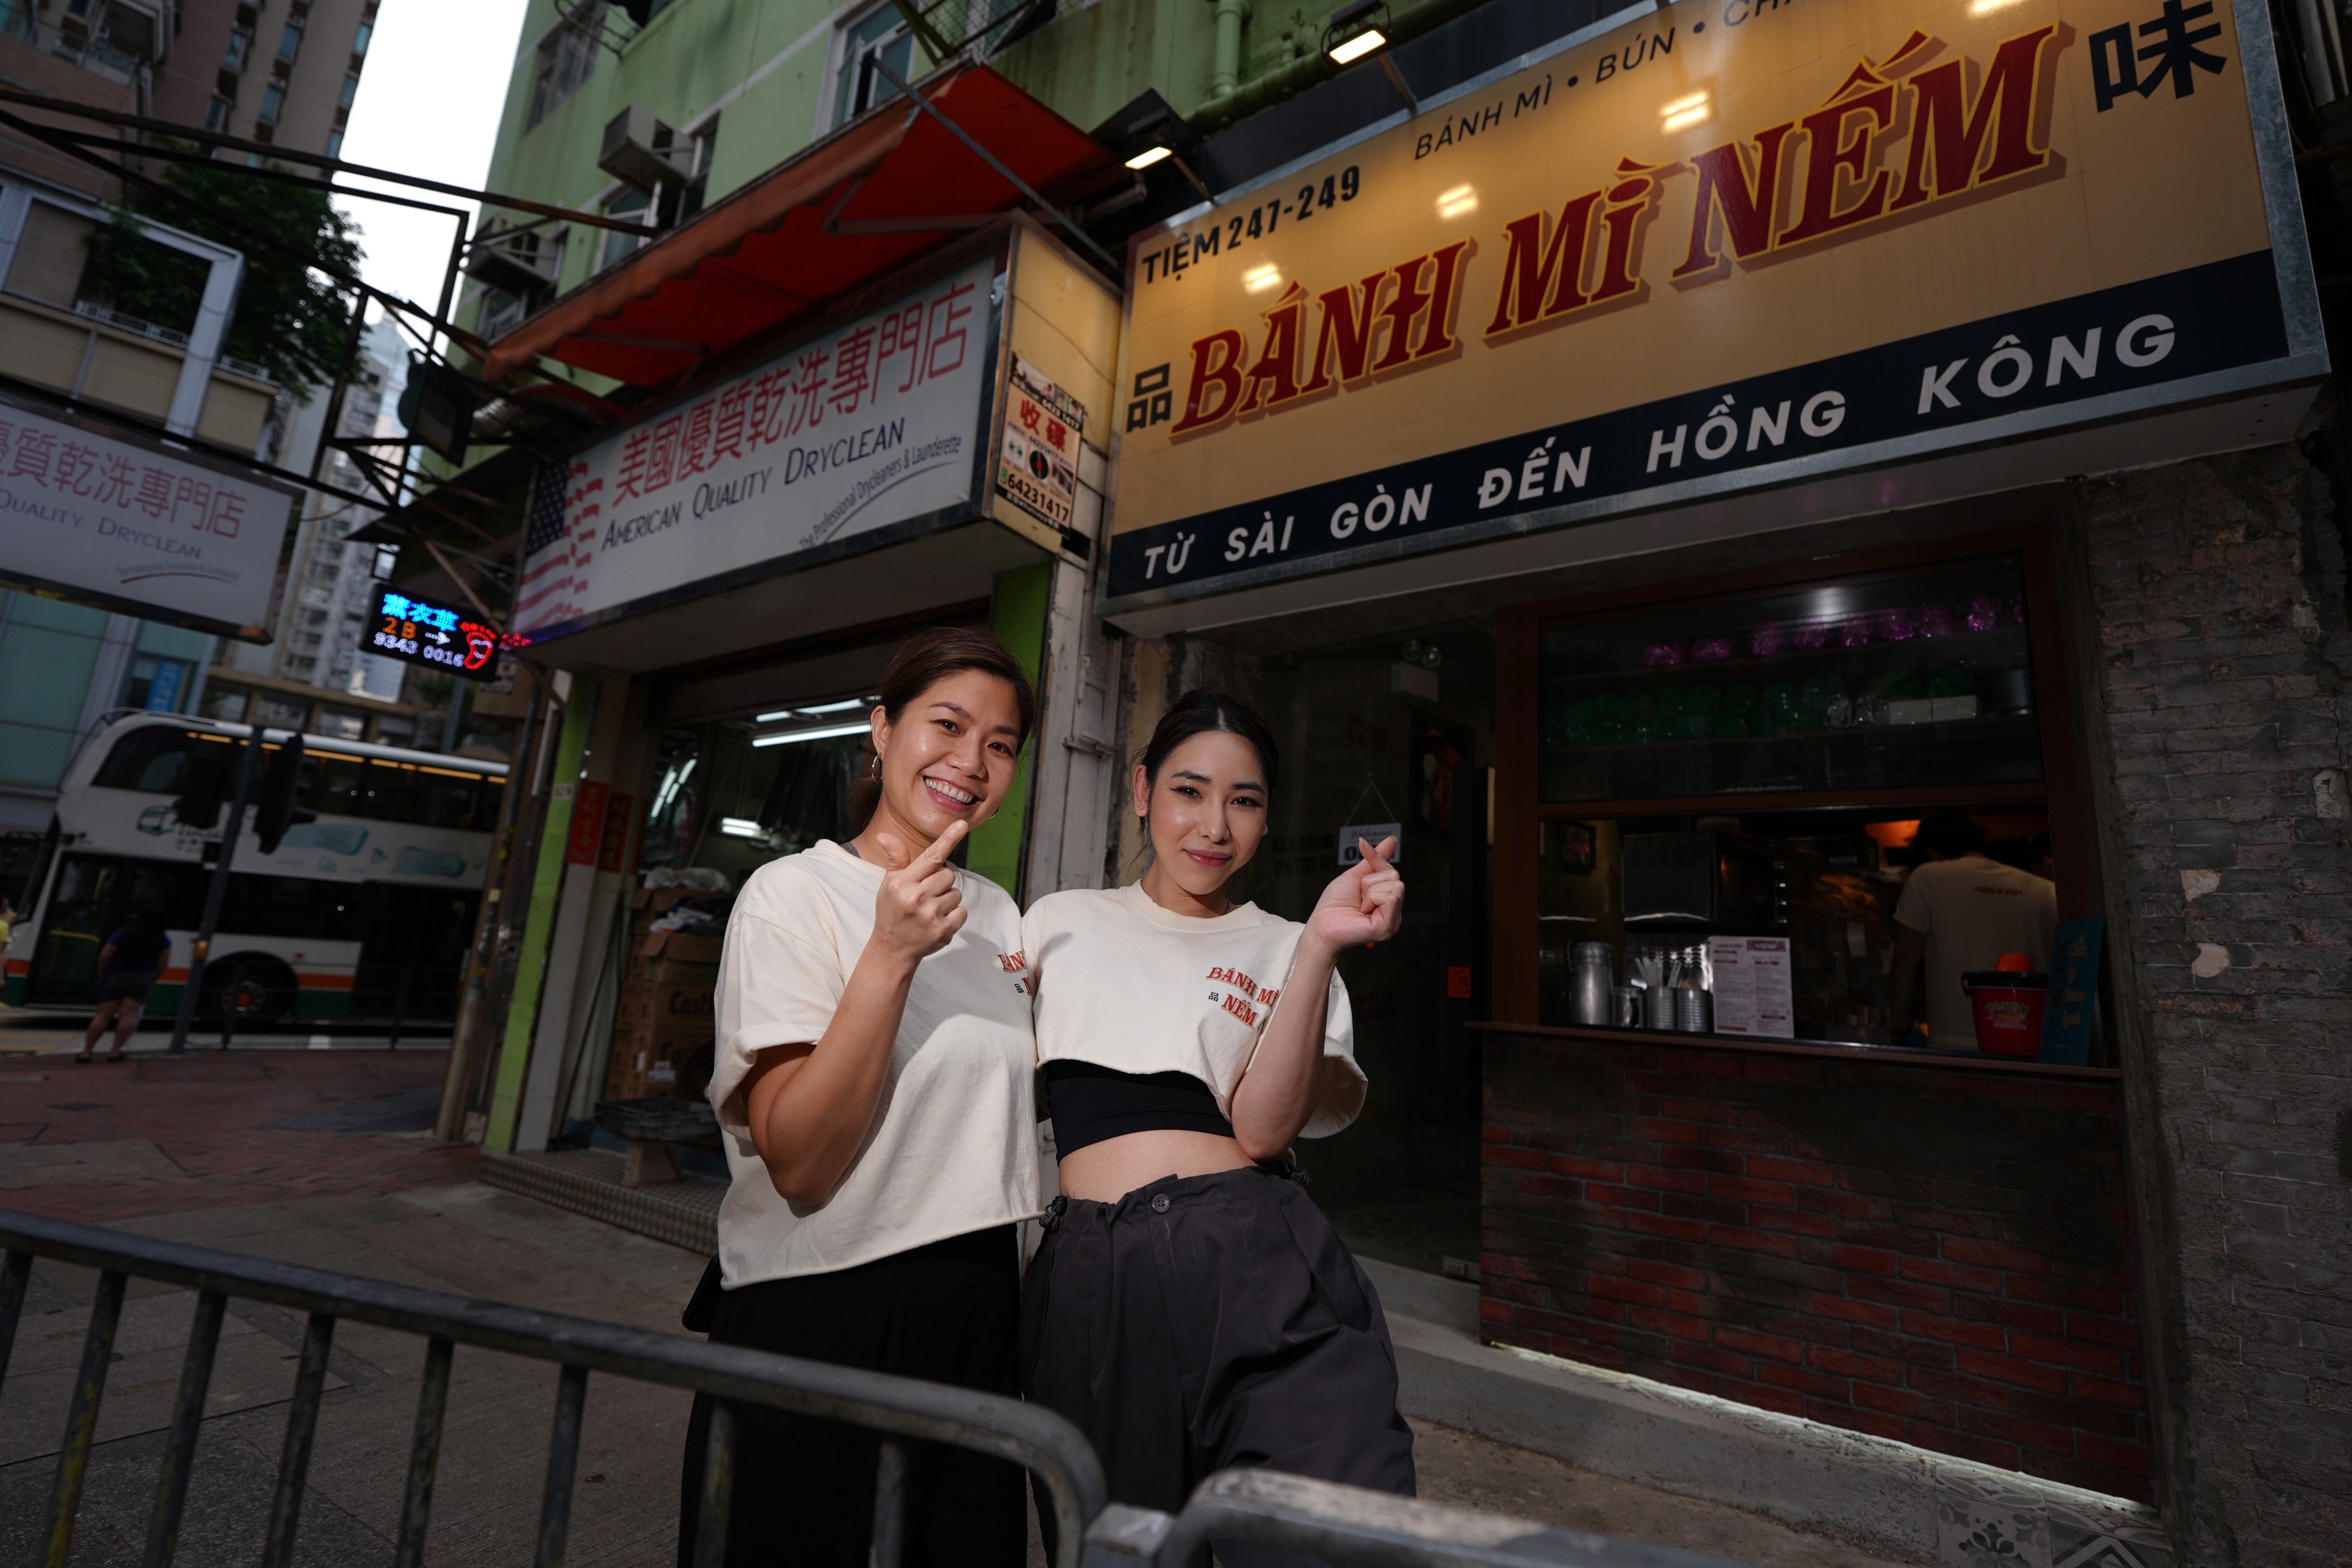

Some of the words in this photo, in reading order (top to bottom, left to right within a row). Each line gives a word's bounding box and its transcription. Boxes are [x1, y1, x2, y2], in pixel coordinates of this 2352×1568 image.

[1415, 102, 1502, 161] BÁNH
[1514, 75, 1553, 117] MÌ
[1594, 27, 1676, 83] BÚN
[1724, 0, 1791, 26] CH
[2088, 0, 2227, 113] 味
[1142, 225, 1221, 284] TIỆM
[1226, 166, 1360, 250] 247-249
[1169, 237, 1477, 442] BÁNH
[1482, 154, 1678, 346] MÌ
[1670, 21, 2070, 286] NẾM
[612, 281, 976, 509] 美國優質乾洗專門店
[1019, 398, 1067, 453] 收碟
[1041, 397, 1063, 420] 6423
[1062, 410, 1080, 431] 1417
[1126, 363, 1171, 433] 品
[1144, 531, 1196, 579] TỪ
[1223, 512, 1295, 562] SÀI
[1330, 483, 1433, 539] GÒN
[1477, 436, 1592, 509] ĐẾN
[1646, 395, 1846, 473] HỒNG
[1918, 314, 2176, 415] KÔNG
[602, 500, 682, 552] AMERICAN
[692, 466, 774, 520] QUALITY
[785, 417, 906, 486] DRYCLEAN
[812, 486, 856, 540] Professional
[856, 458, 902, 500] Drycleaners
[903, 449, 910, 469] &
[911, 434, 962, 465] Launderette
[1006, 473, 1069, 522] 64231417
[98, 517, 202, 560] DRYCLEAN
[1014, 983, 1025, 994] 品
[1206, 967, 1258, 999] BÁNH
[1208, 991, 1219, 1002] 品
[1221, 994, 1260, 1029] NẾM
